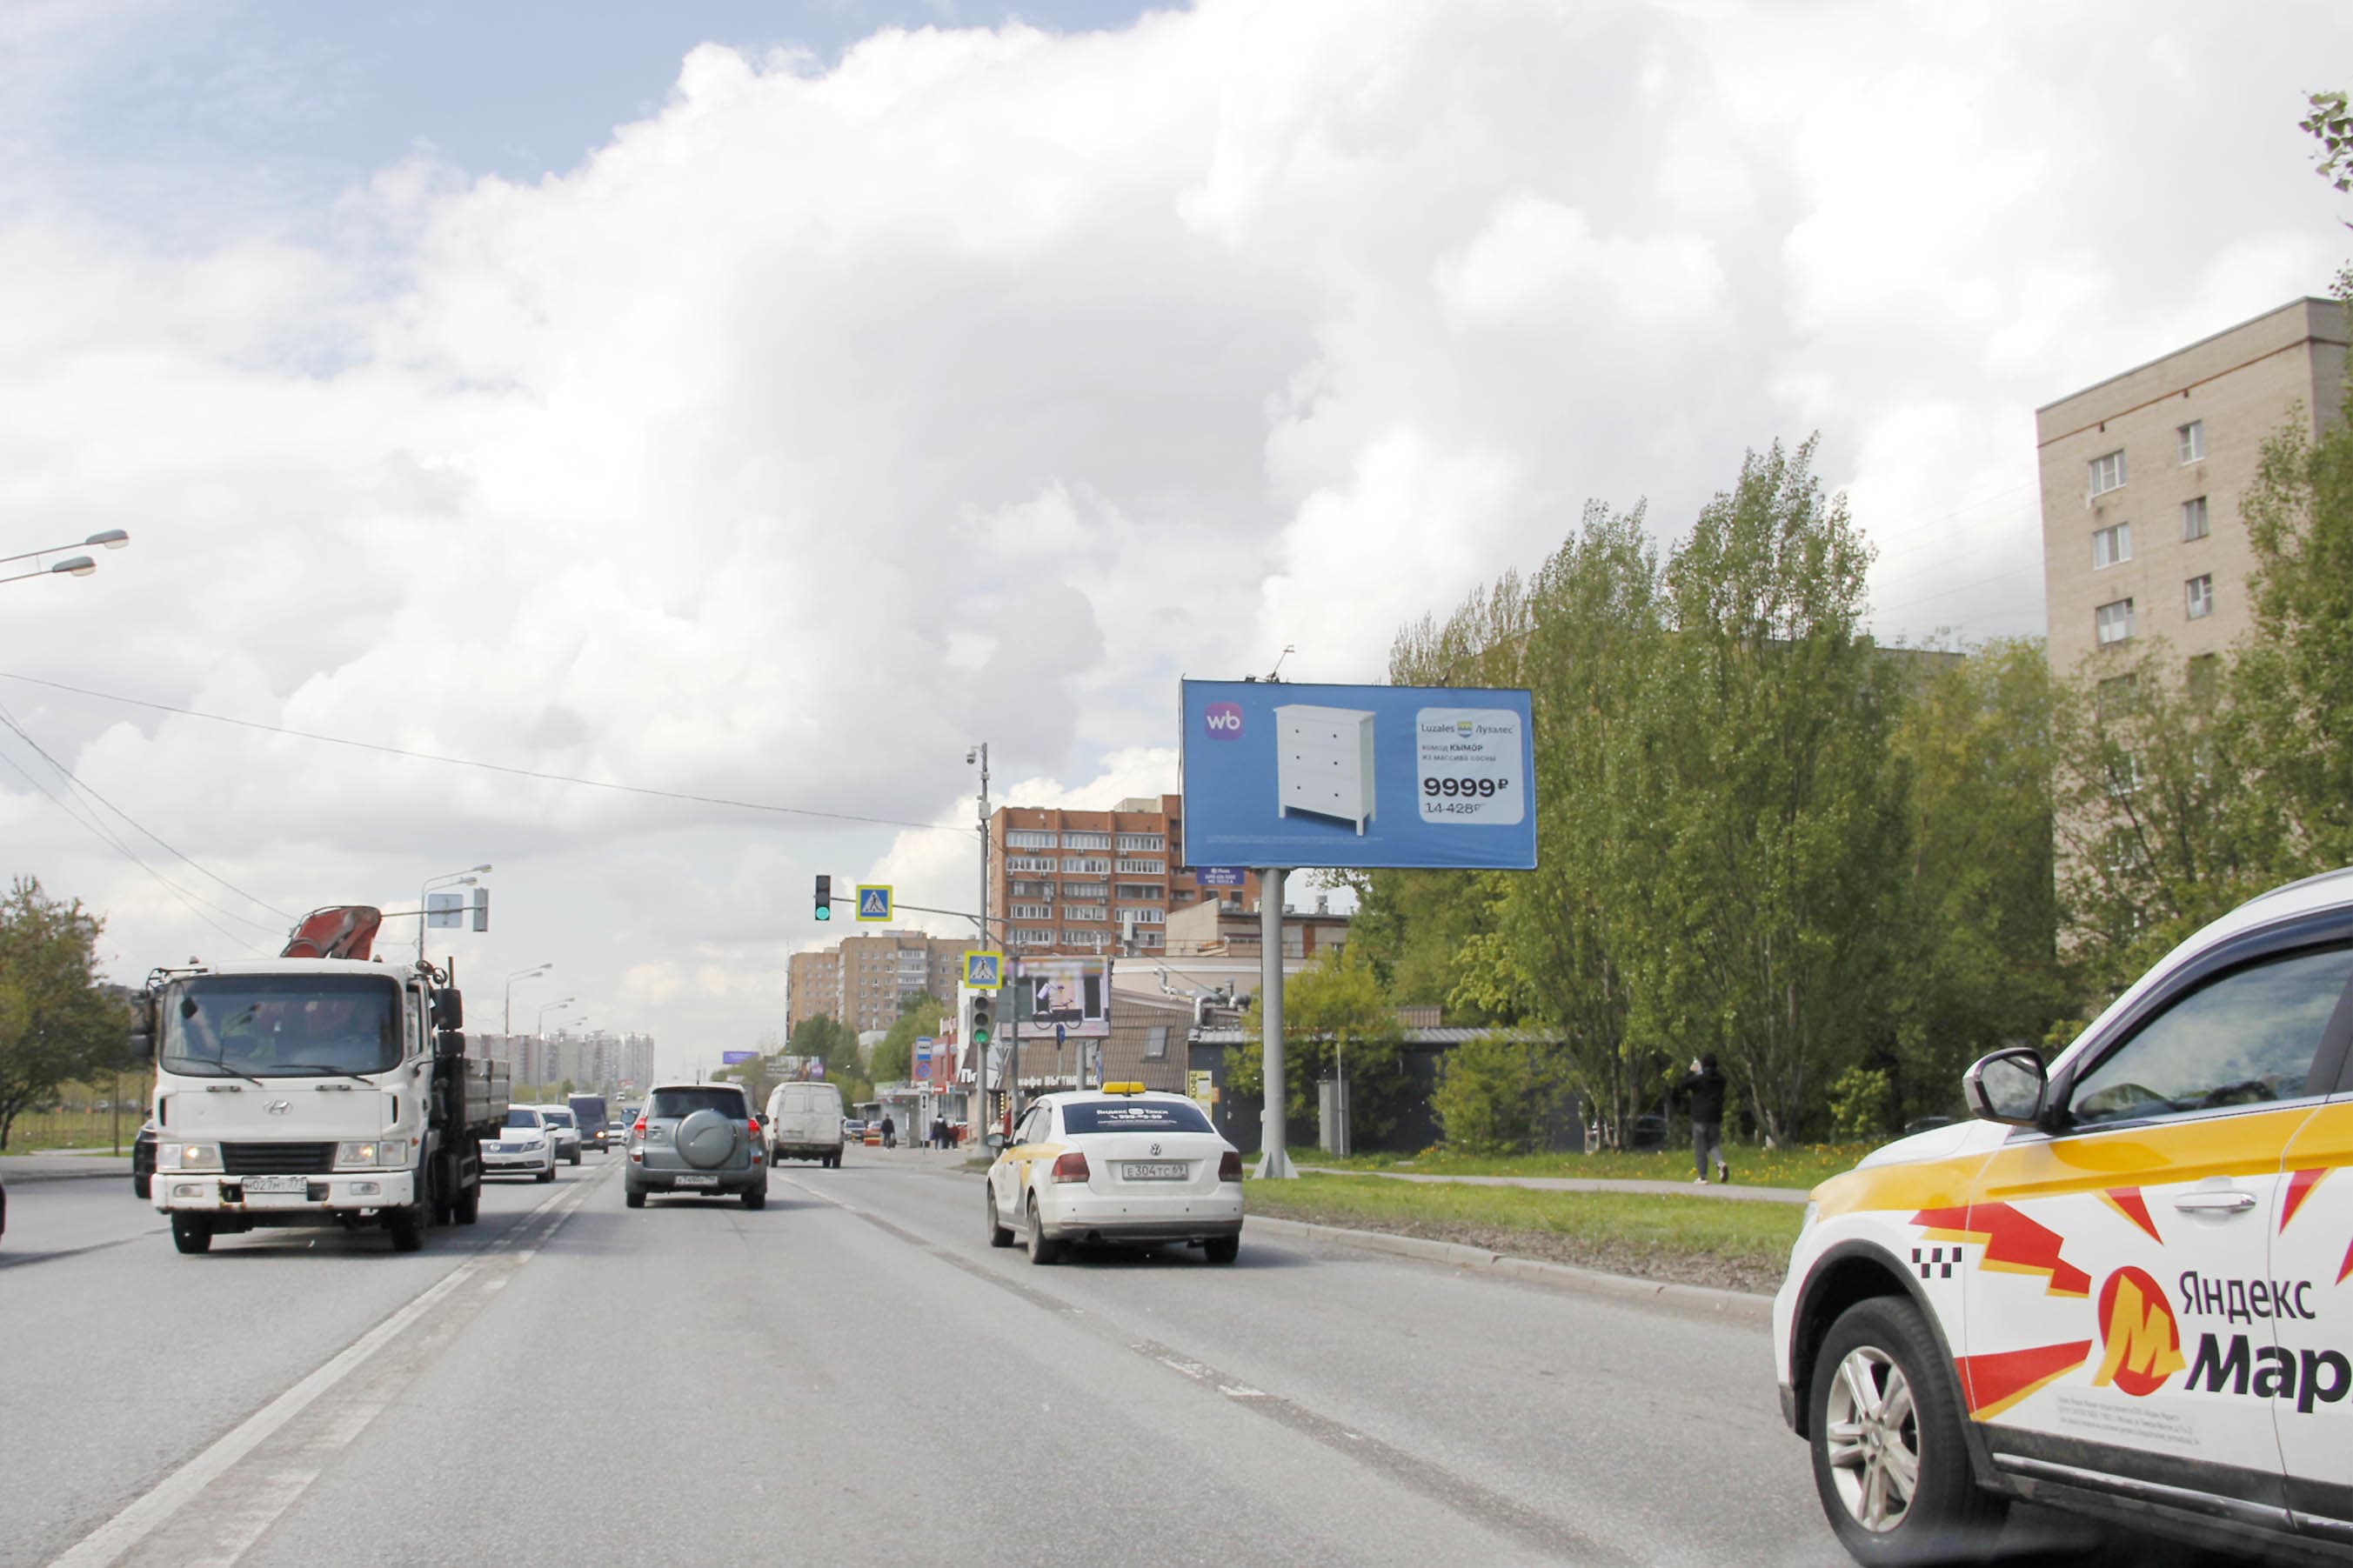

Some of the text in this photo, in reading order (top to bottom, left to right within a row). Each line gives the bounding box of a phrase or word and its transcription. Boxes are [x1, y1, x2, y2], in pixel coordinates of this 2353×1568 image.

[1207, 710, 1240, 730] wb
[1421, 724, 1455, 733] Luzales
[2179, 1271, 2316, 1324] Яндекс
[2184, 1332, 2353, 1413] Мар
